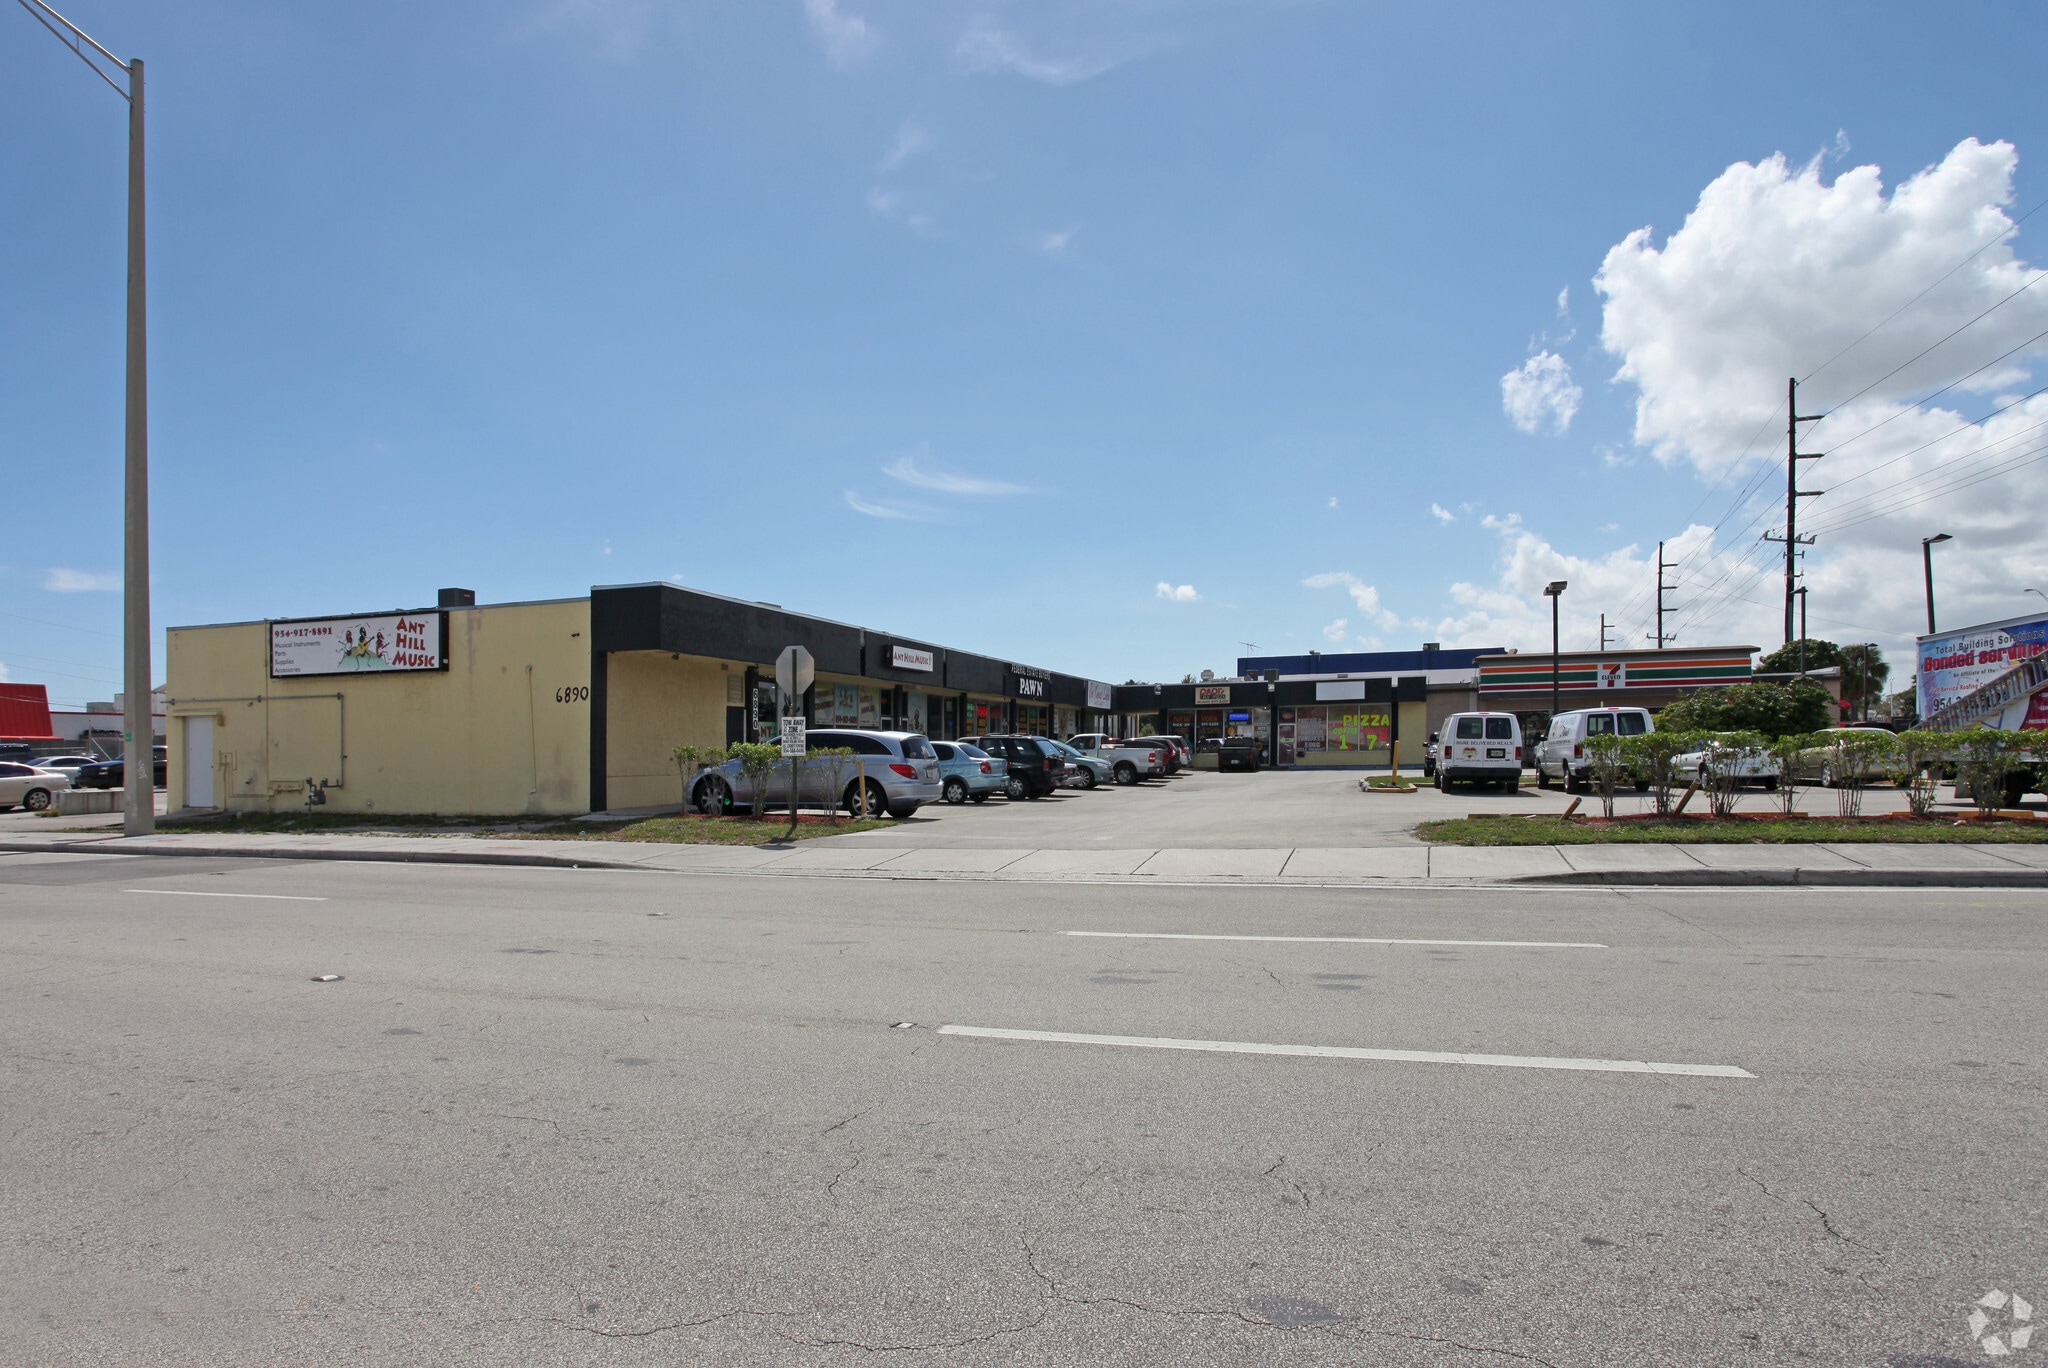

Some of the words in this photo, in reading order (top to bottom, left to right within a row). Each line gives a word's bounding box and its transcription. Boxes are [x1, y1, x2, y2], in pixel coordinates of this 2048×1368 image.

[275, 627, 333, 638] 954-917-8891
[396, 617, 425, 635] ANT
[396, 633, 425, 651] HILL
[1936, 644, 1955, 654] Total
[1958, 639, 1994, 651] Building
[1998, 630, 2045, 645] Solutions
[392, 650, 435, 668] MUSIC
[1924, 650, 1975, 672] Bonded
[1607, 664, 1621, 687] 7
[556, 686, 589, 704] 6890
[1020, 678, 1043, 697] PAWN
[1960, 683, 1978, 691] Roofing
[1343, 714, 1390, 727] PIZZA
